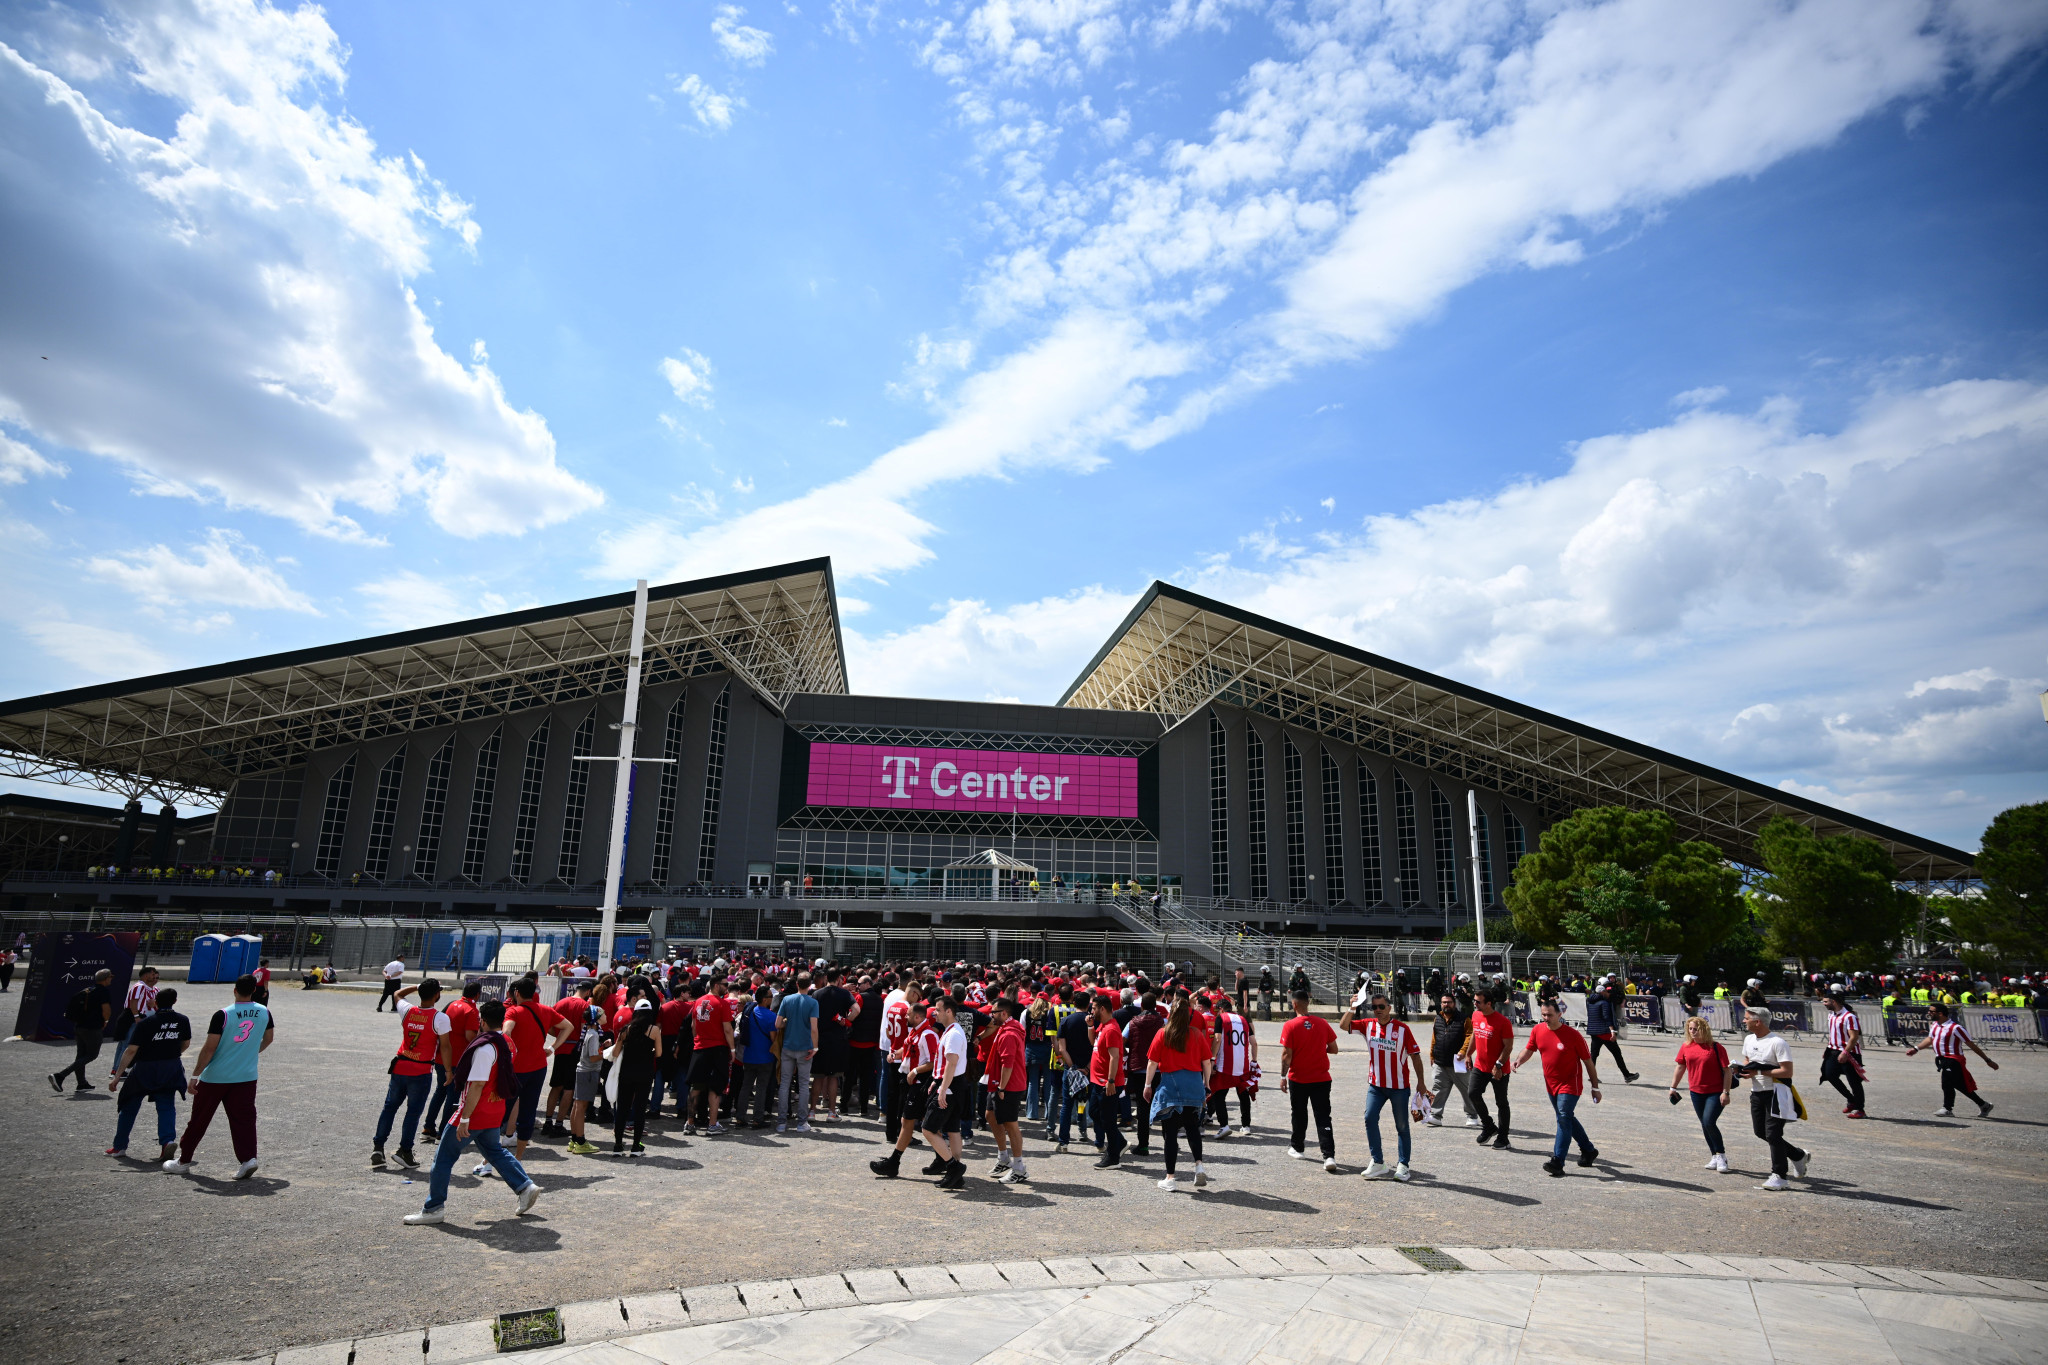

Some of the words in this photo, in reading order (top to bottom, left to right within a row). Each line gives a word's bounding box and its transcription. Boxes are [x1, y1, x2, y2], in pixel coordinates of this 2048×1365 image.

[930, 761, 1069, 800] Center
[481, 985, 501, 995] GLORY
[1626, 1001, 1648, 1009] GAME
[236, 1009, 261, 1019] WADE
[1624, 1007, 1650, 1019] TERS
[1771, 1011, 1798, 1022] LORY
[1896, 1012, 1922, 1020] EVERY
[1981, 1014, 2018, 1023] ATHENS
[407, 1022, 425, 1031] PMS
[887, 1013, 902, 1038] 56
[1989, 1025, 2014, 1033] 2026
[152, 1031, 165, 1041] ALL
[233, 1020, 254, 1043] 3
[1030, 1024, 1044, 1041] 94
[408, 1031, 421, 1050] 7
[1226, 1029, 1248, 1047] 100
[1371, 1036, 1396, 1046] SIEMENS
